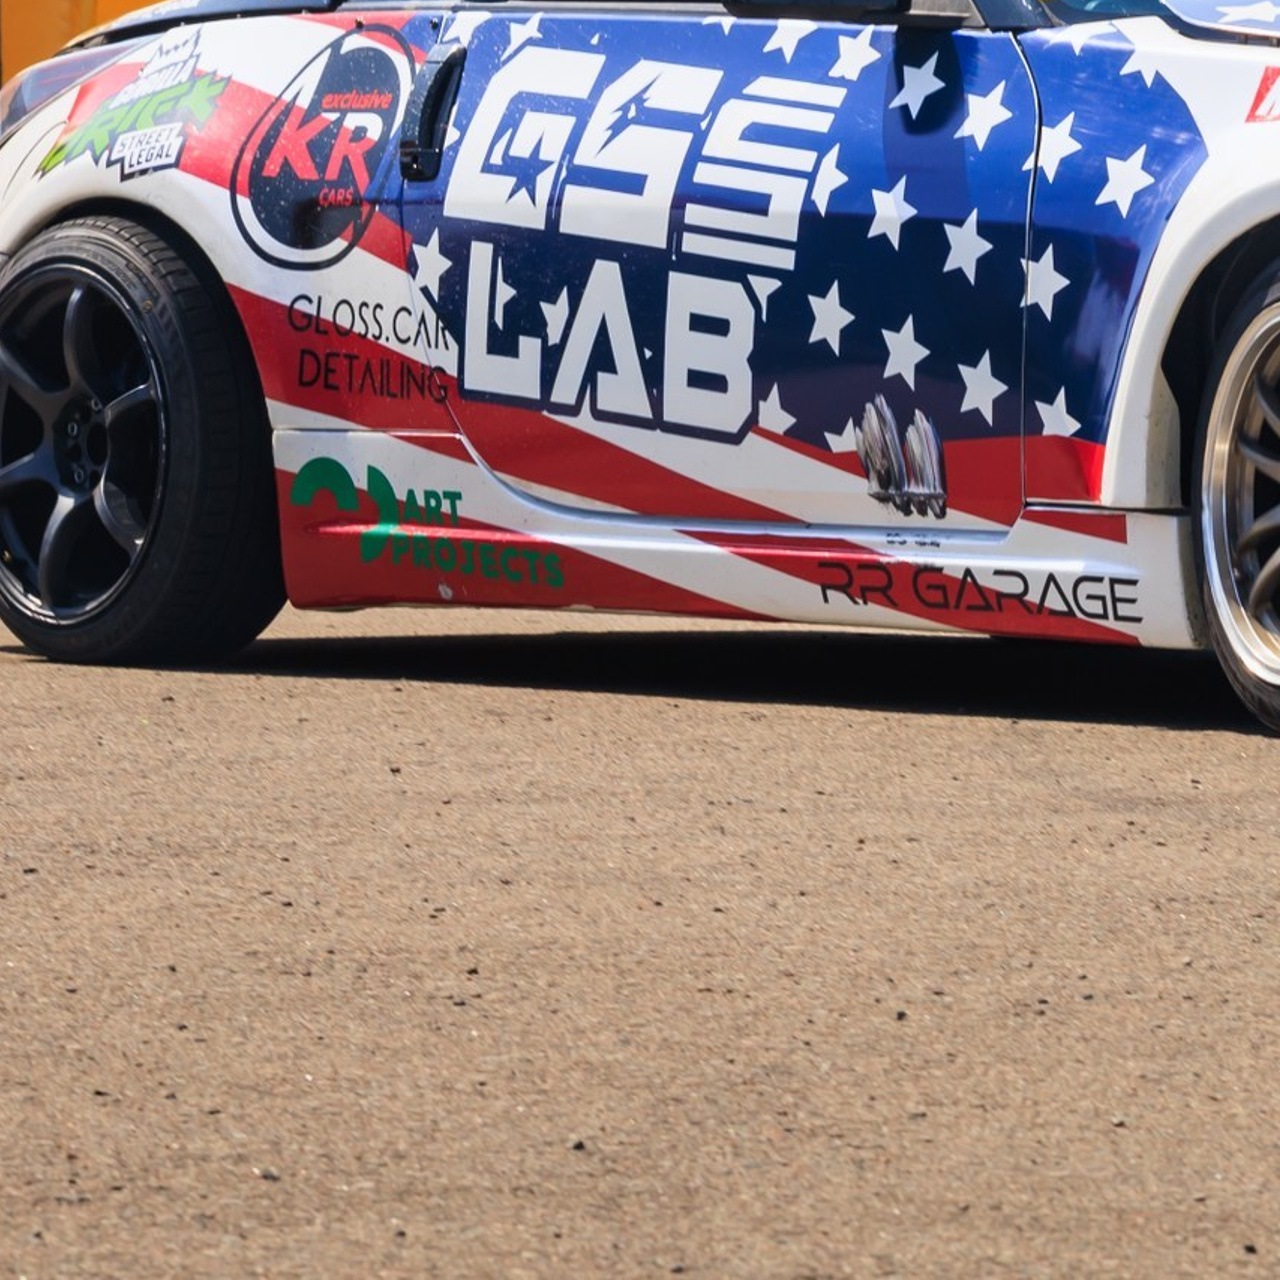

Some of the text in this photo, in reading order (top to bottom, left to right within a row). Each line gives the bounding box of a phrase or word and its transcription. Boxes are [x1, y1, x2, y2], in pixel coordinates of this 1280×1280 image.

[322, 92, 392, 110] exclusive
[117, 125, 175, 151] STREET
[128, 143, 173, 169] LEGAL
[262, 108, 384, 210] KR
[318, 187, 354, 206] CARS
[463, 240, 756, 435] LAB
[298, 349, 450, 404] DETAILING
[402, 488, 462, 526] ART
[391, 532, 565, 588] PROJECTS
[817, 562, 1144, 623] RR GARAGE
